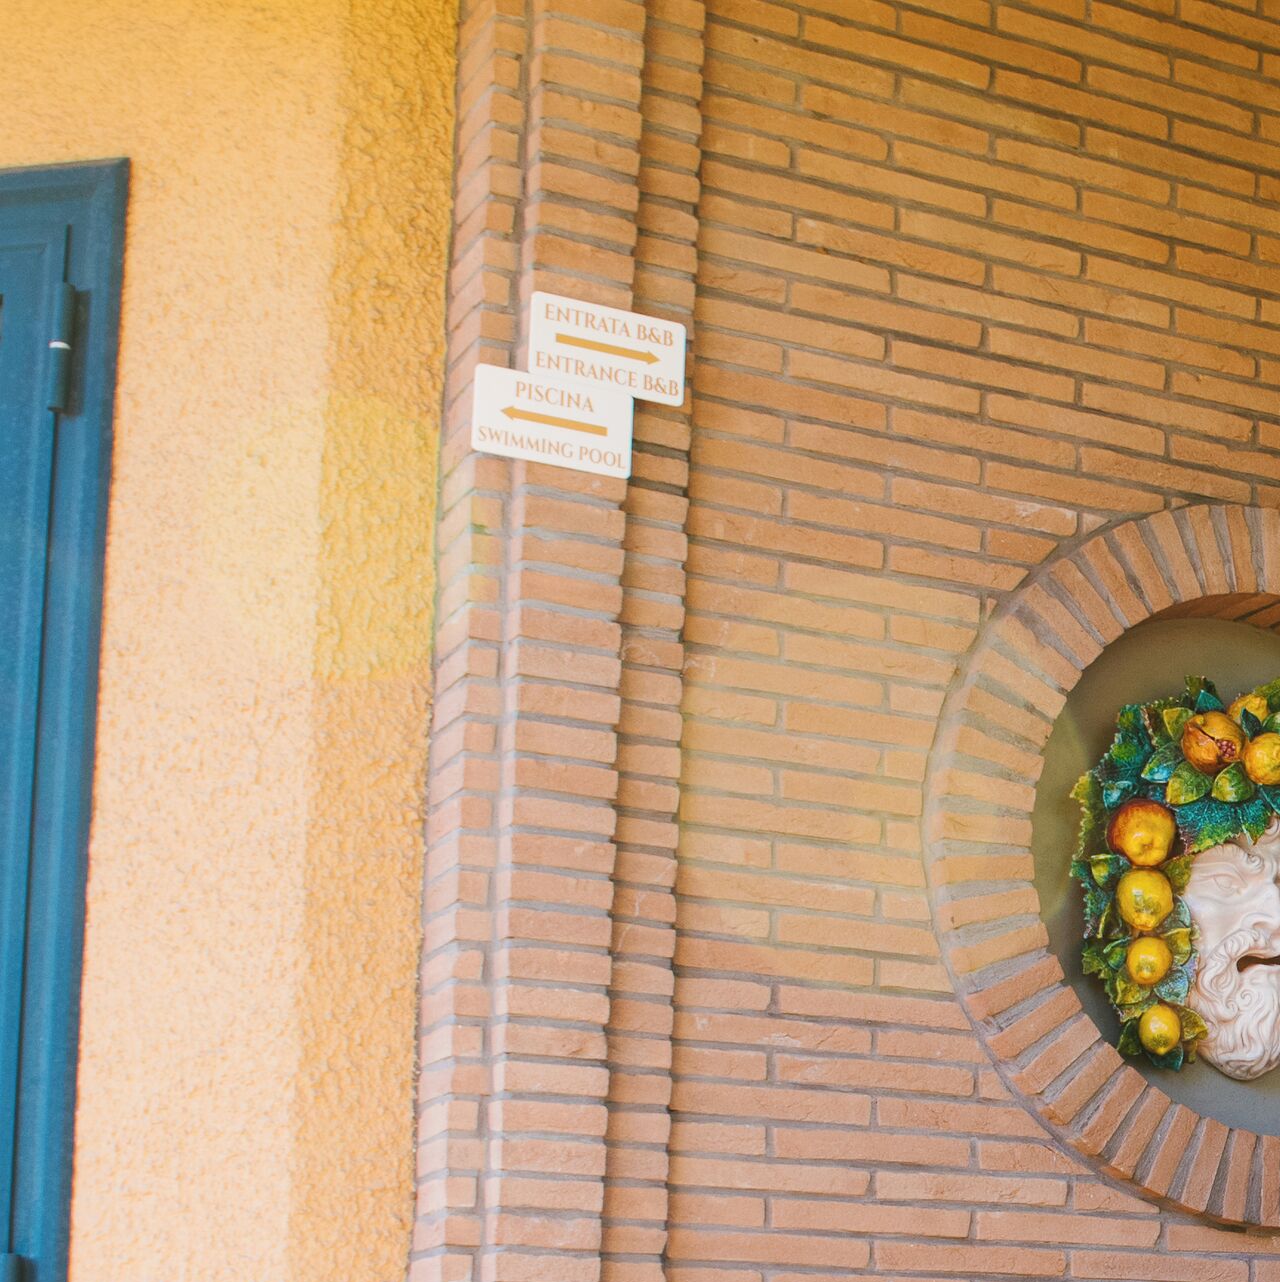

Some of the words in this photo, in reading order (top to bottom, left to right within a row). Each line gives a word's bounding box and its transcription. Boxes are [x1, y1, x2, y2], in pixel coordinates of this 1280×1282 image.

[544, 302, 631, 338] ENTRATA
[637, 324, 674, 347] B&B
[535, 351, 638, 388] ENTRANCE
[643, 374, 679, 397] B&B
[515, 381, 594, 413] PISCINA
[478, 426, 573, 458] SWIMMING
[579, 446, 626, 469] POOL
